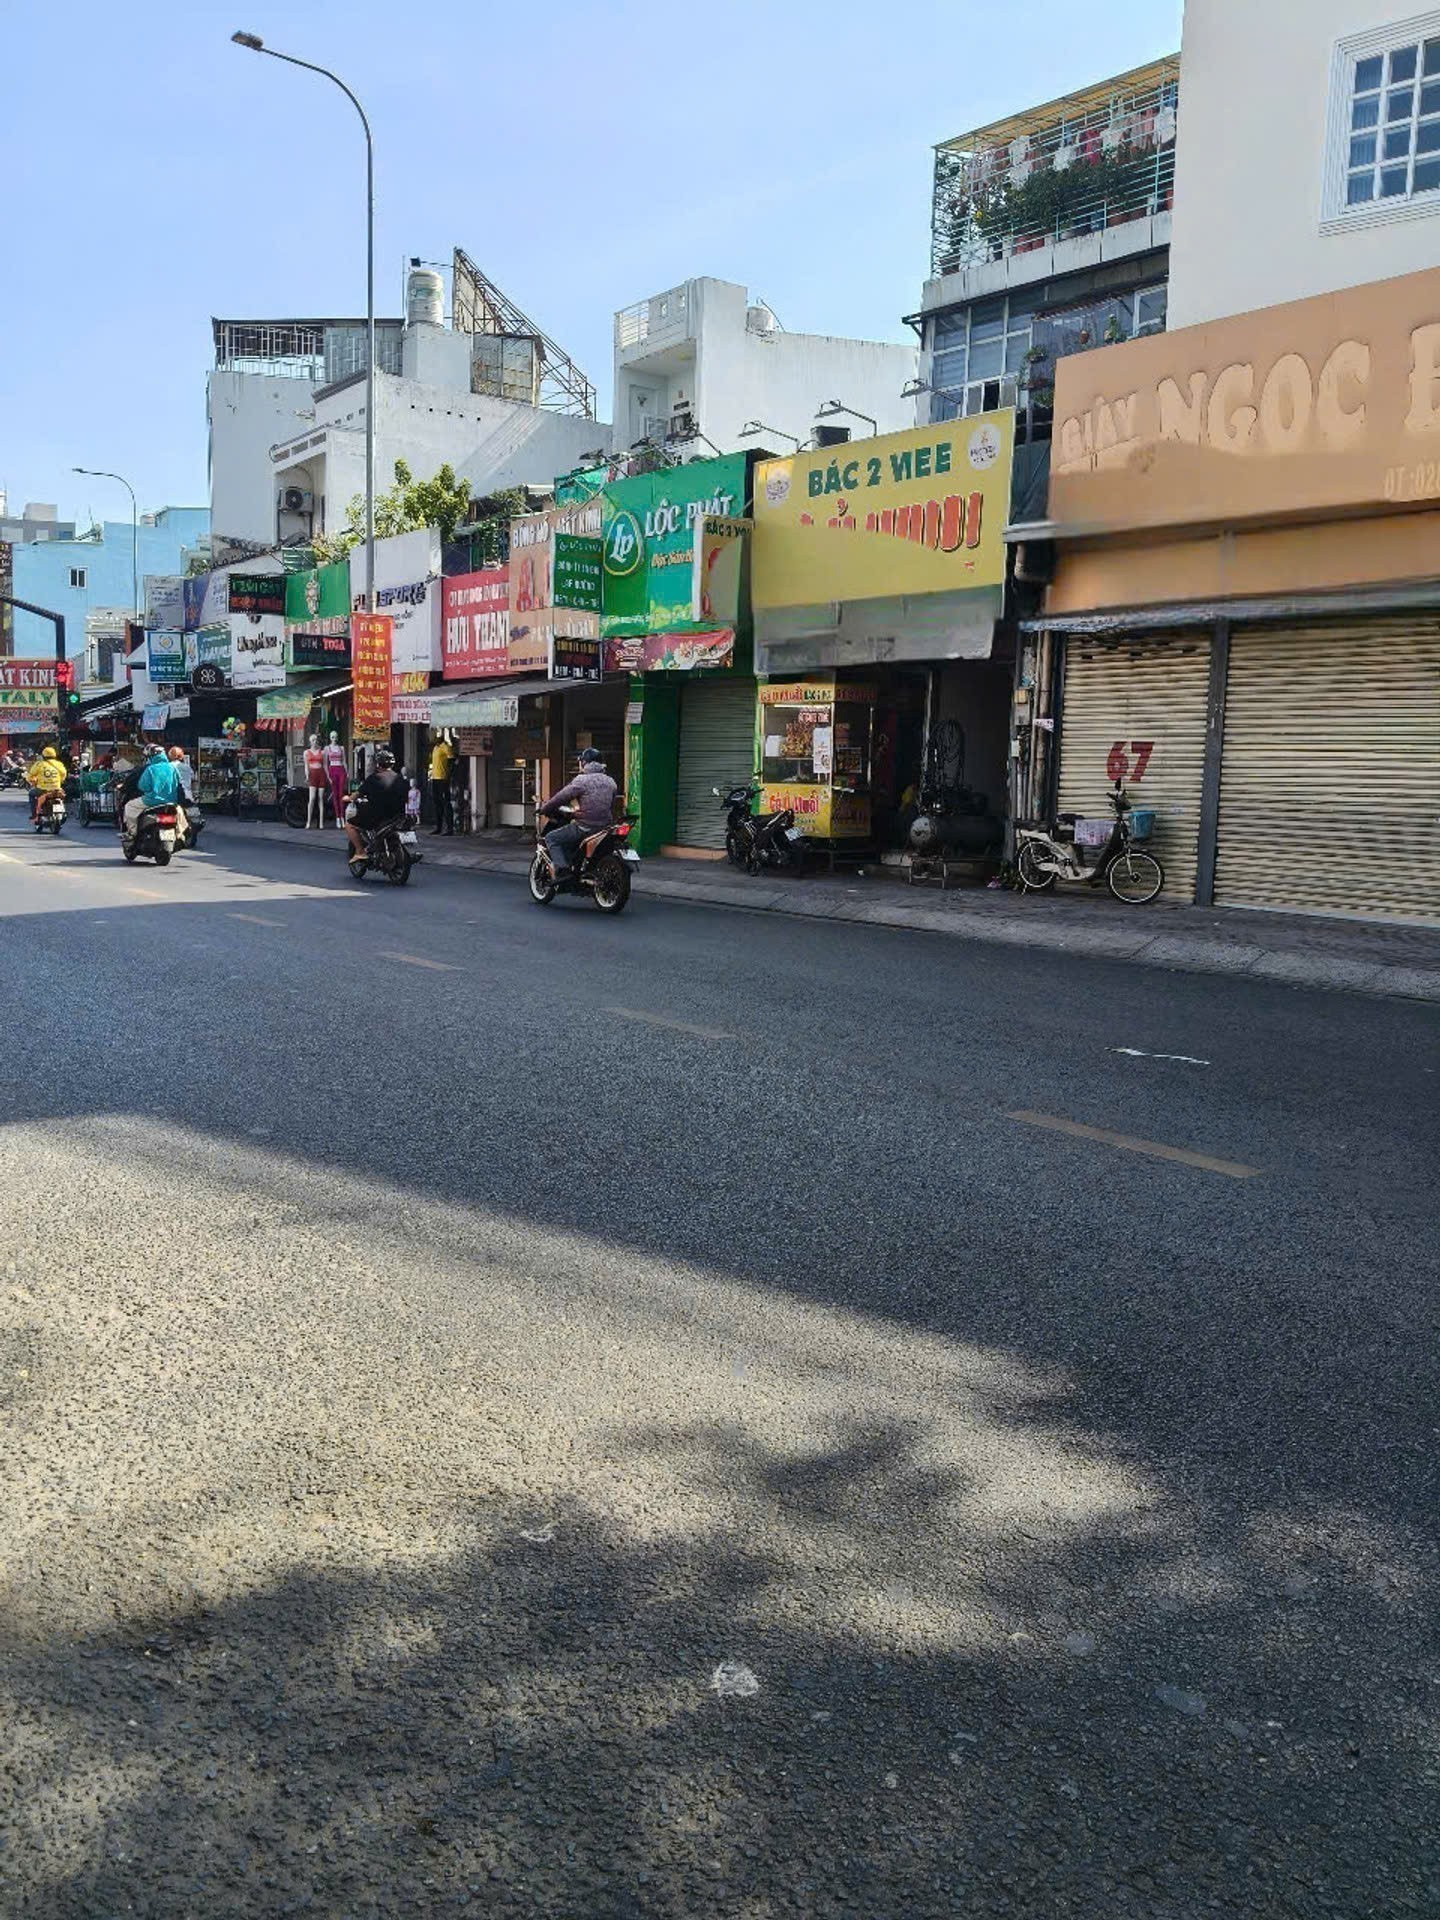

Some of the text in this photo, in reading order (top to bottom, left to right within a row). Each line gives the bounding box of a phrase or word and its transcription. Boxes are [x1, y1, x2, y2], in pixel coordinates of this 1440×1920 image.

[808, 456, 860, 498] BÁC
[866, 457, 881, 487] 2
[645, 498, 681, 541] LỘC
[1106, 741, 1155, 783] 67
